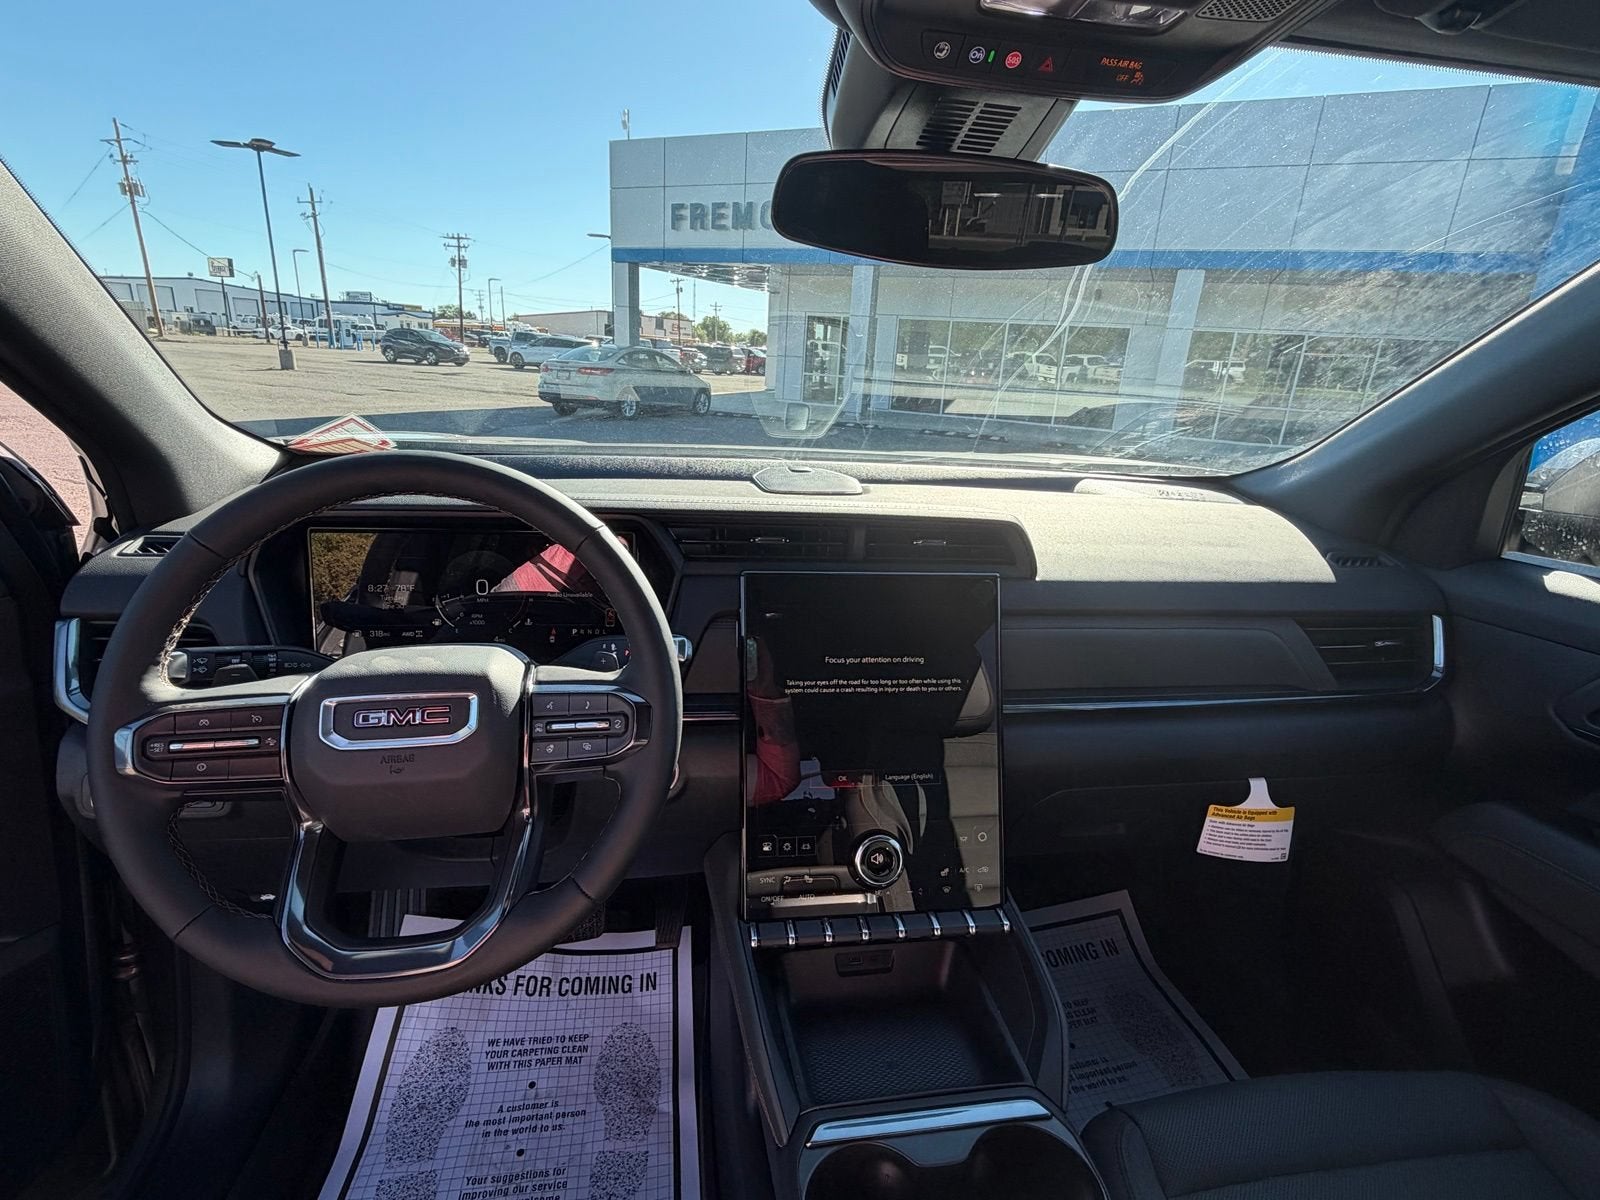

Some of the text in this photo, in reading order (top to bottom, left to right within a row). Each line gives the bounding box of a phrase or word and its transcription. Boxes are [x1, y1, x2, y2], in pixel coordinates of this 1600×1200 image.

[1007, 56, 1021, 66] SOS
[1101, 57, 1142, 69] PASS AIR BAG
[368, 584, 388, 593] 8:27
[476, 579, 489, 595] 0
[825, 655, 925, 665] Focus your attention on driving
[786, 679, 803, 687] Taking
[784, 687, 803, 695] system
[855, 686, 878, 694] resulting
[353, 705, 451, 728] GMC
[380, 753, 415, 764] AIRBAG
[884, 771, 934, 782] Language (English)
[759, 876, 776, 885] SYNC
[761, 894, 785, 903] ON/OFF
[799, 893, 816, 901] AUTO
[1100, 937, 1120, 957] IN
[513, 974, 552, 998] FOR
[557, 973, 633, 998] COMING
[639, 971, 657, 992] IN
[487, 1033, 590, 1047] WE HAVE TRIED TO KEEP
[485, 1044, 589, 1060] YOUR CARPETING CLEAN
[486, 1056, 584, 1072] WITH THIS PAPER MAT
[497, 1099, 560, 1114] A customer is
[465, 1108, 587, 1128] the most important person
[481, 1122, 566, 1139] in the world to us.
[465, 1167, 567, 1187] Your suggestions for
[458, 1180, 568, 1200] improving our service
